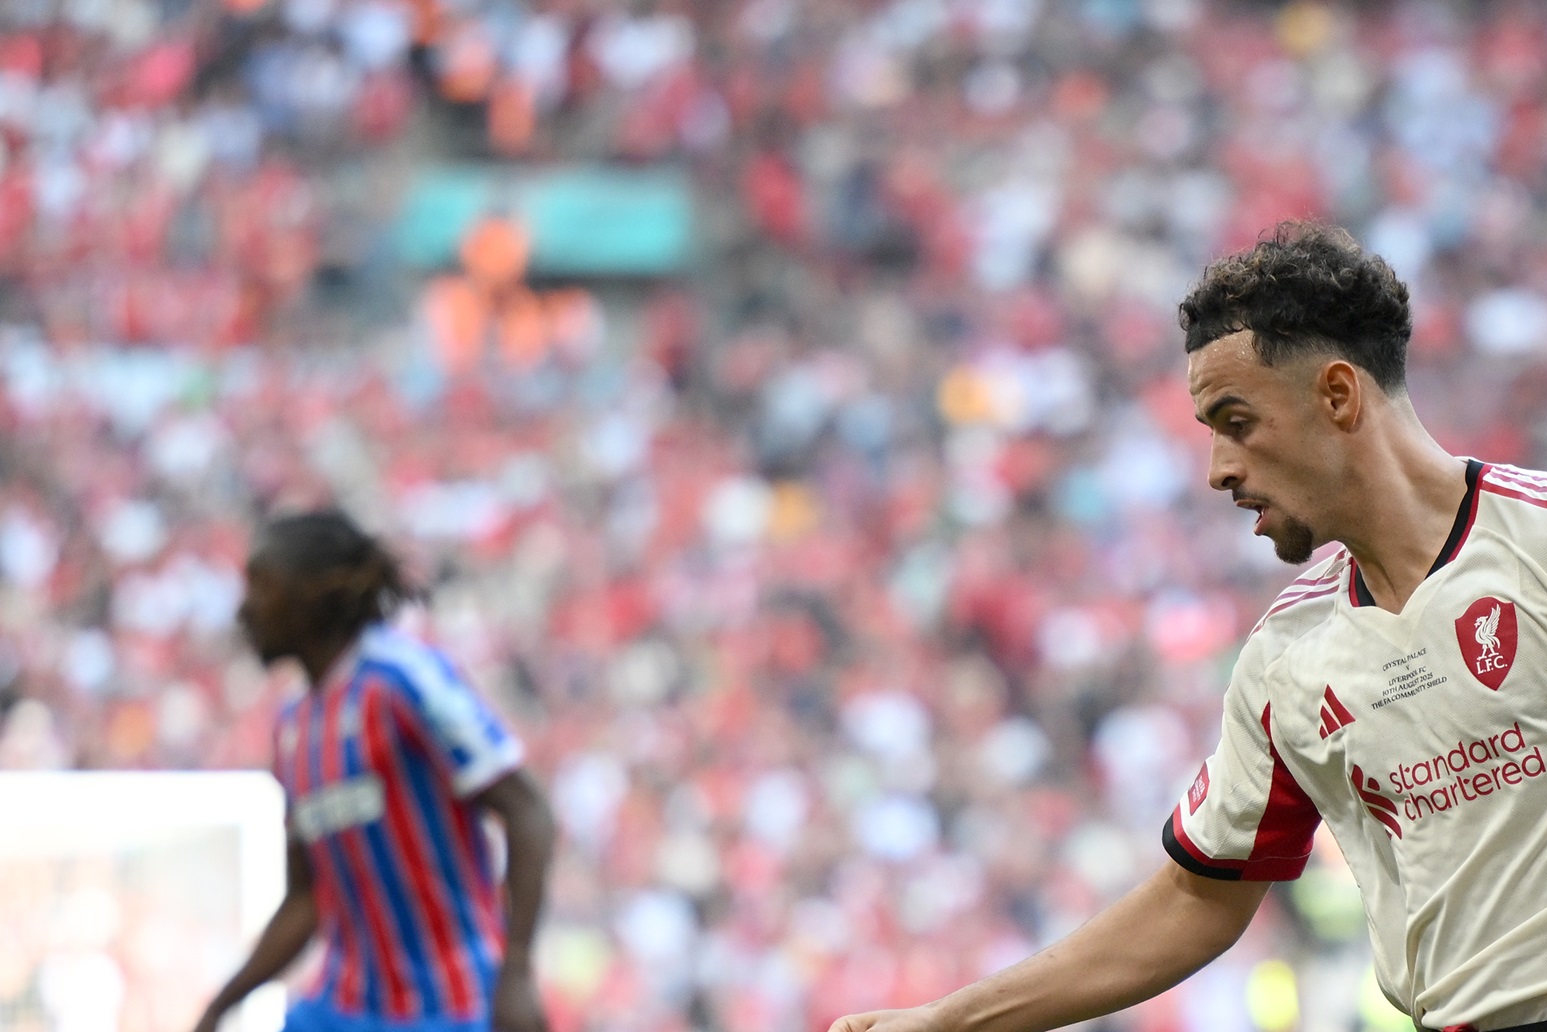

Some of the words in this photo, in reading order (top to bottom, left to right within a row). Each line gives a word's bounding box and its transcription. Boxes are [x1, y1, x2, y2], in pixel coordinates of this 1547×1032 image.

[1382, 657, 1407, 671] CRYSTAL
[1406, 648, 1427, 661] PALACE
[1476, 655, 1508, 674] L.F.C.
[1388, 670, 1418, 686] LIVERPOOL
[1419, 665, 1427, 673] FC
[1397, 677, 1419, 691] AUGUST
[1419, 672, 1434, 683] 2025
[1371, 700, 1384, 710] THE
[1391, 684, 1426, 702] COMMUNITY
[1426, 676, 1448, 689] SHIELD
[1389, 721, 1526, 795] standard
[1404, 746, 1547, 821] chartered
